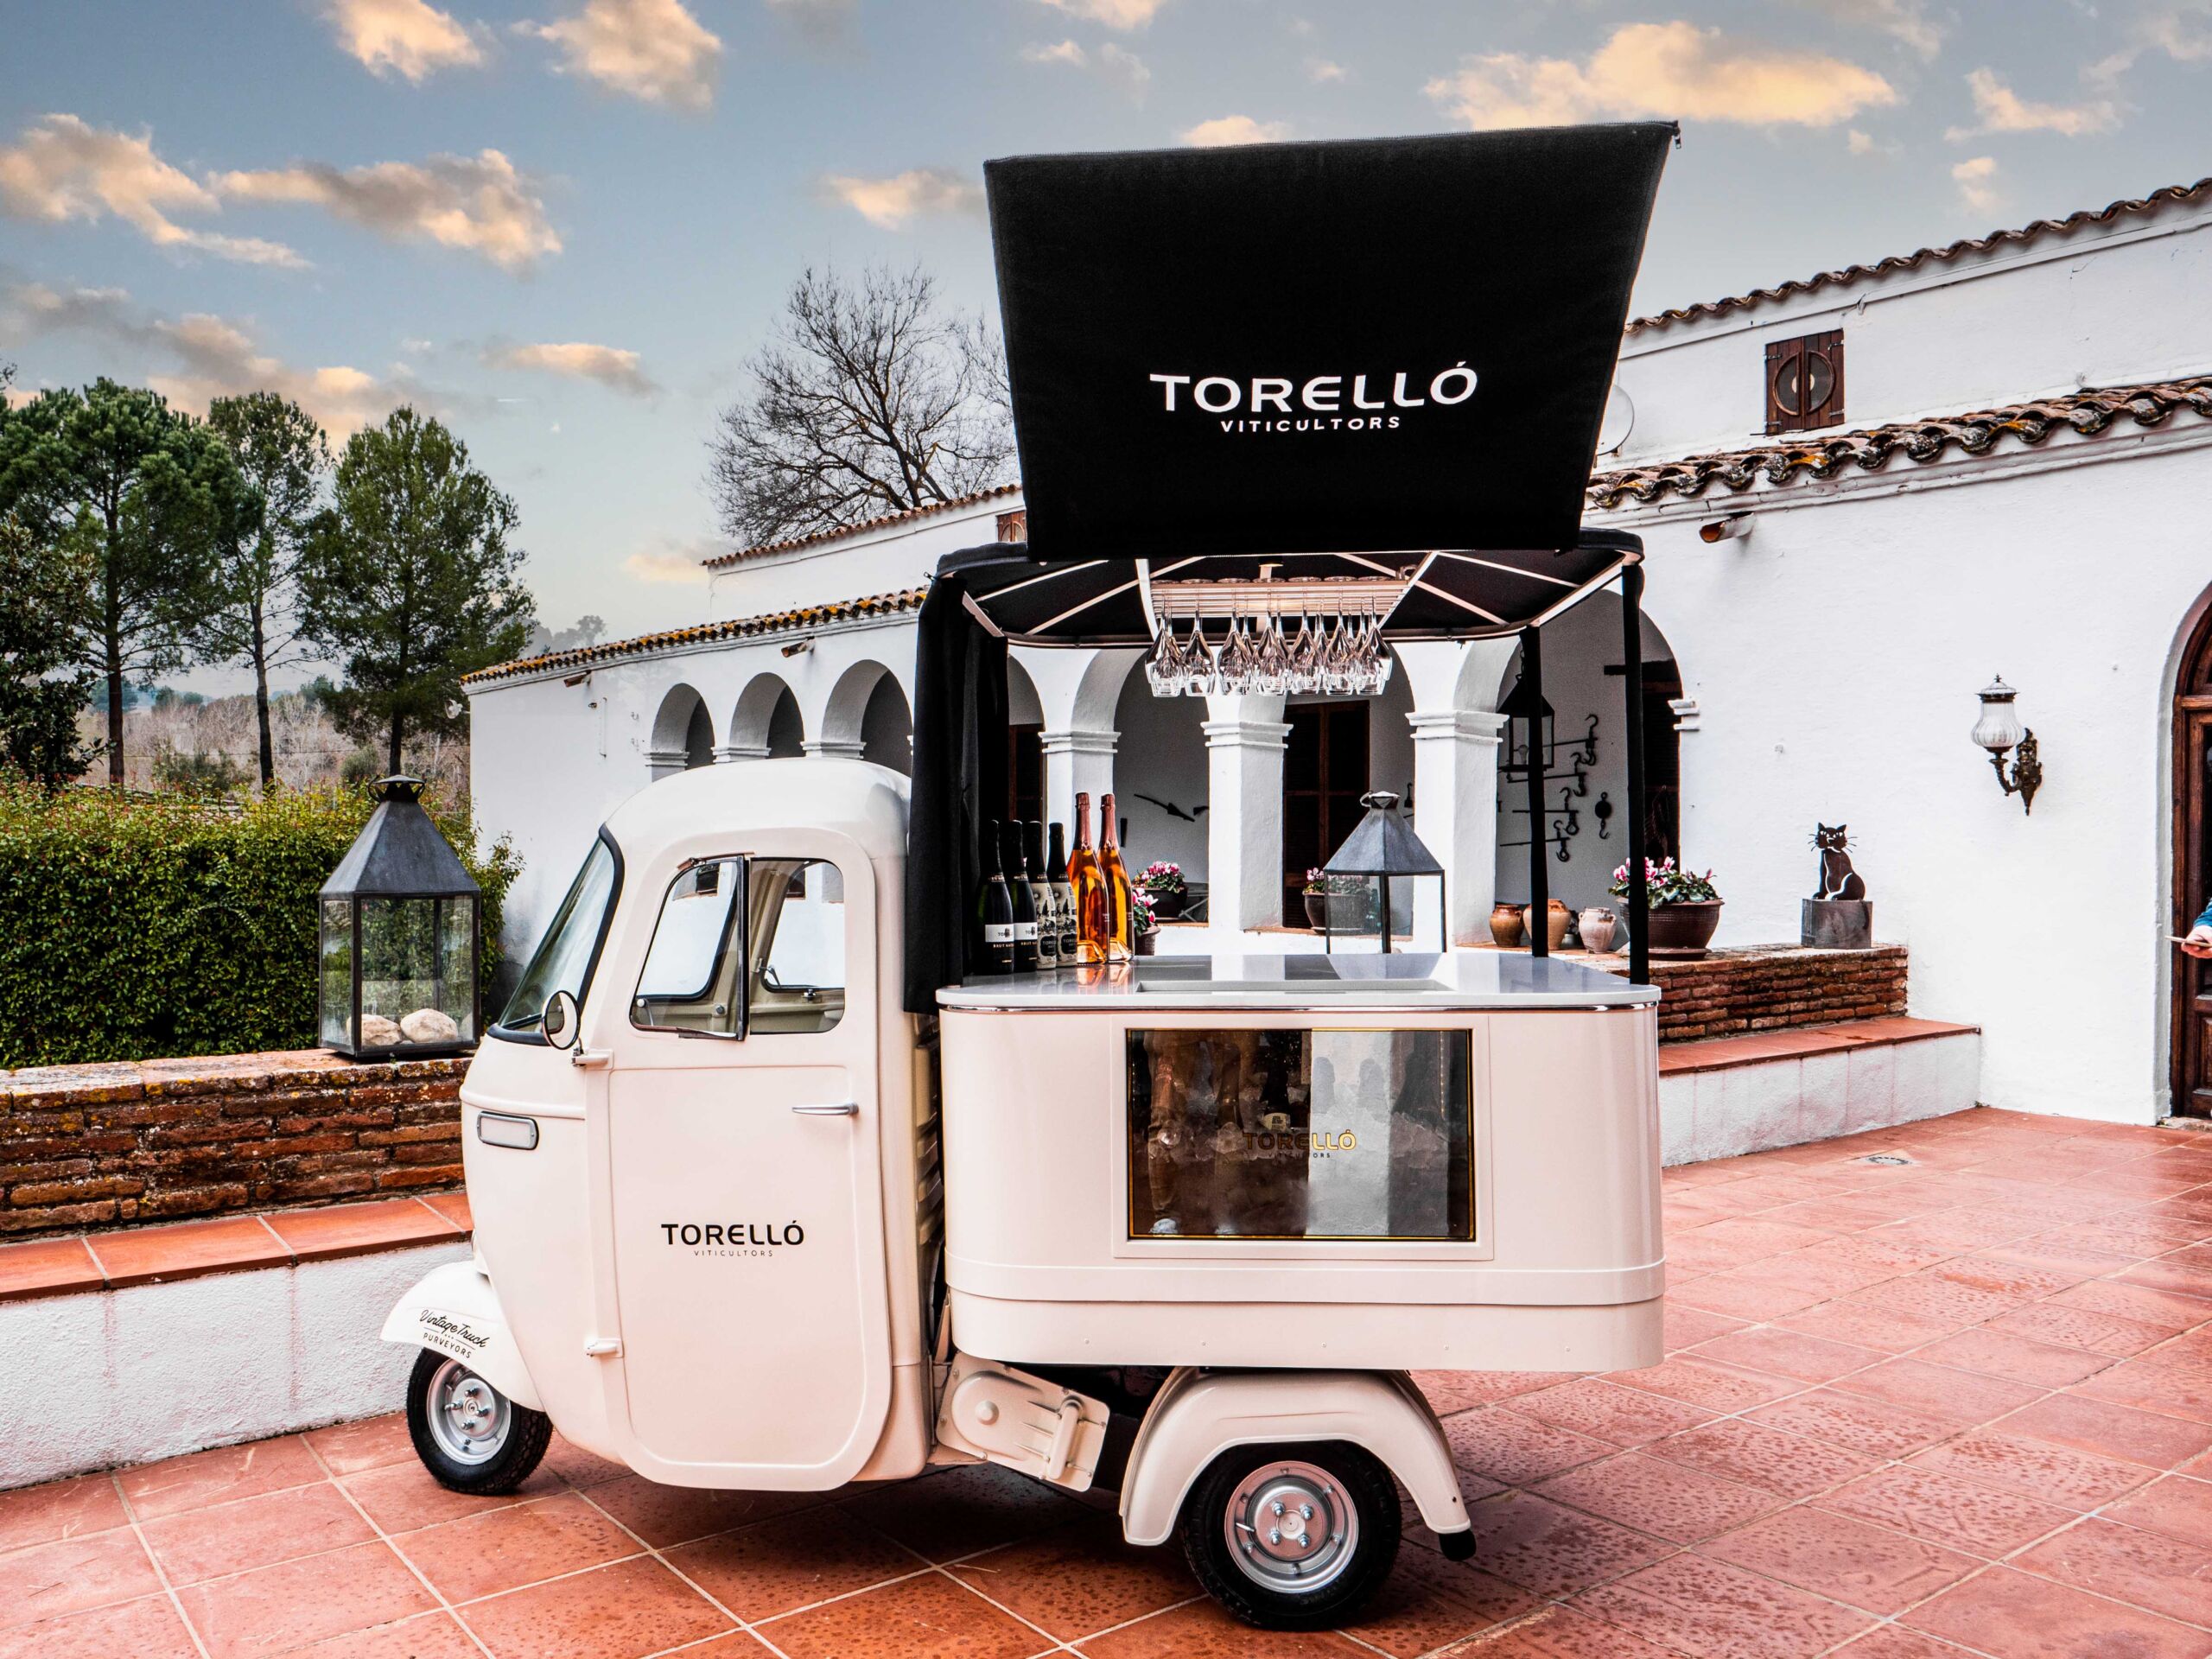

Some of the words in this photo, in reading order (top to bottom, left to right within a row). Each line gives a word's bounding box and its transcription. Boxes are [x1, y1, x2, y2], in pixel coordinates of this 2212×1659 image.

[1149, 360, 1478, 413] TORELLÓ
[1220, 416, 1401, 433] VITICULTORS
[1243, 1129, 1357, 1151] TORELLÓ
[661, 1220, 804, 1246] TORELLÓ
[419, 1309, 458, 1334] Vintage
[457, 1323, 490, 1348] Truck
[423, 1332, 472, 1359] PURVEYORS
